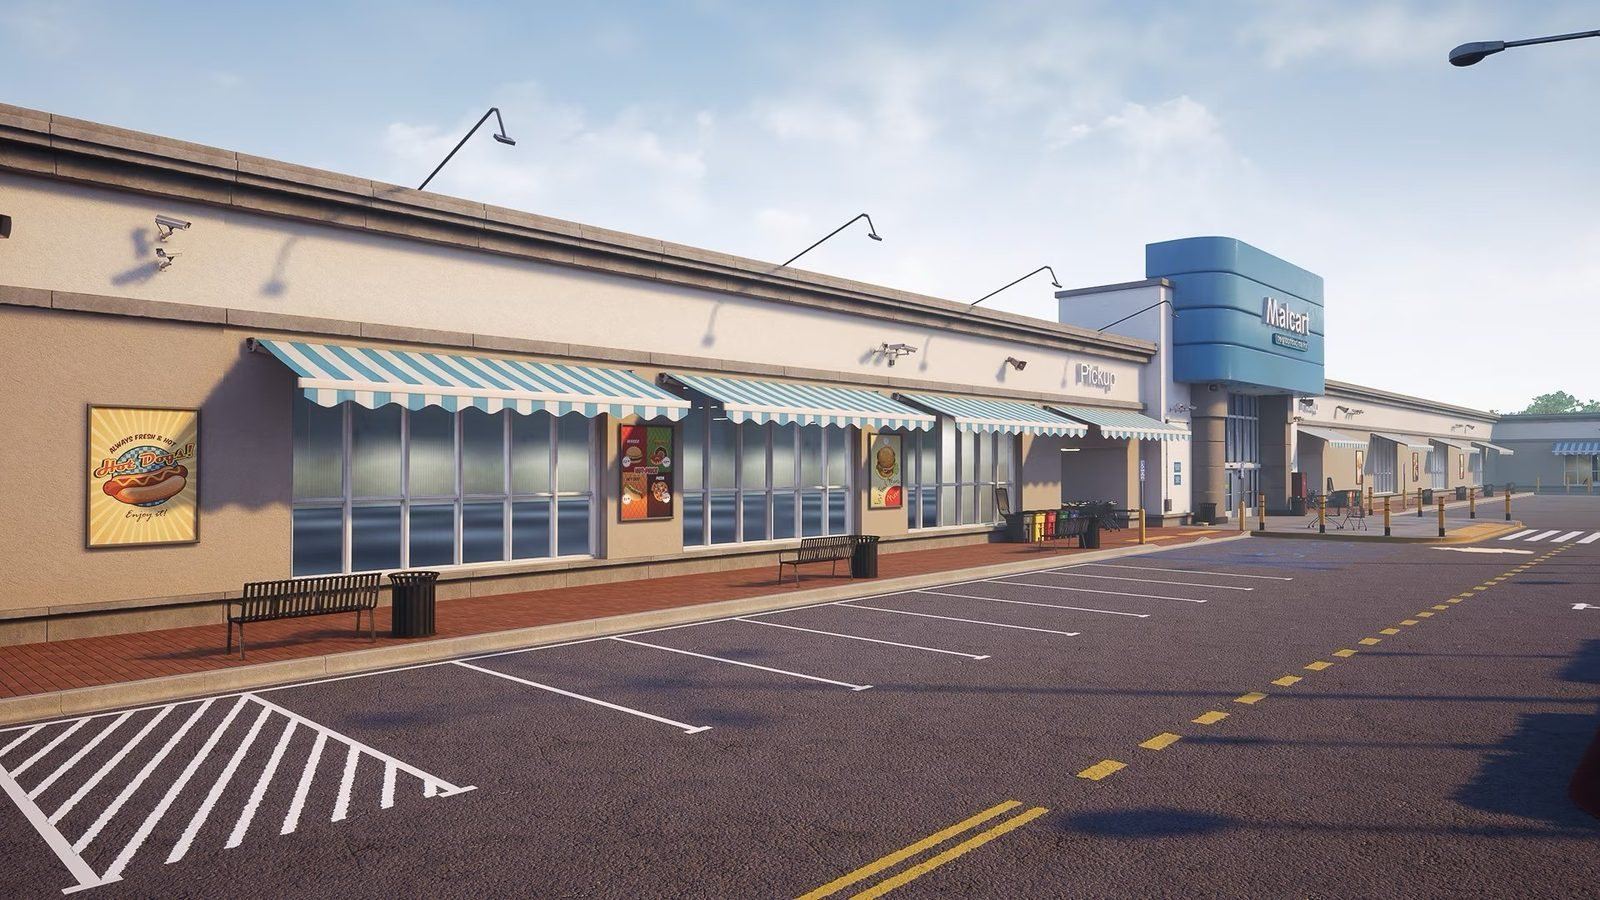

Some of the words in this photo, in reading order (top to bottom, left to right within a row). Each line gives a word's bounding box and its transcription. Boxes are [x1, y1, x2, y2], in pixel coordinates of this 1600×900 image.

[1264, 296, 1310, 336] Malcart
[1080, 362, 1117, 389] Pickup
[109, 436, 133, 454] ALWAYS
[163, 437, 177, 447] HOT
[93, 457, 136, 478] Hot
[137, 442, 195, 467] Dogs!
[125, 509, 152, 523] Enjoy
[155, 508, 168, 517] it!
